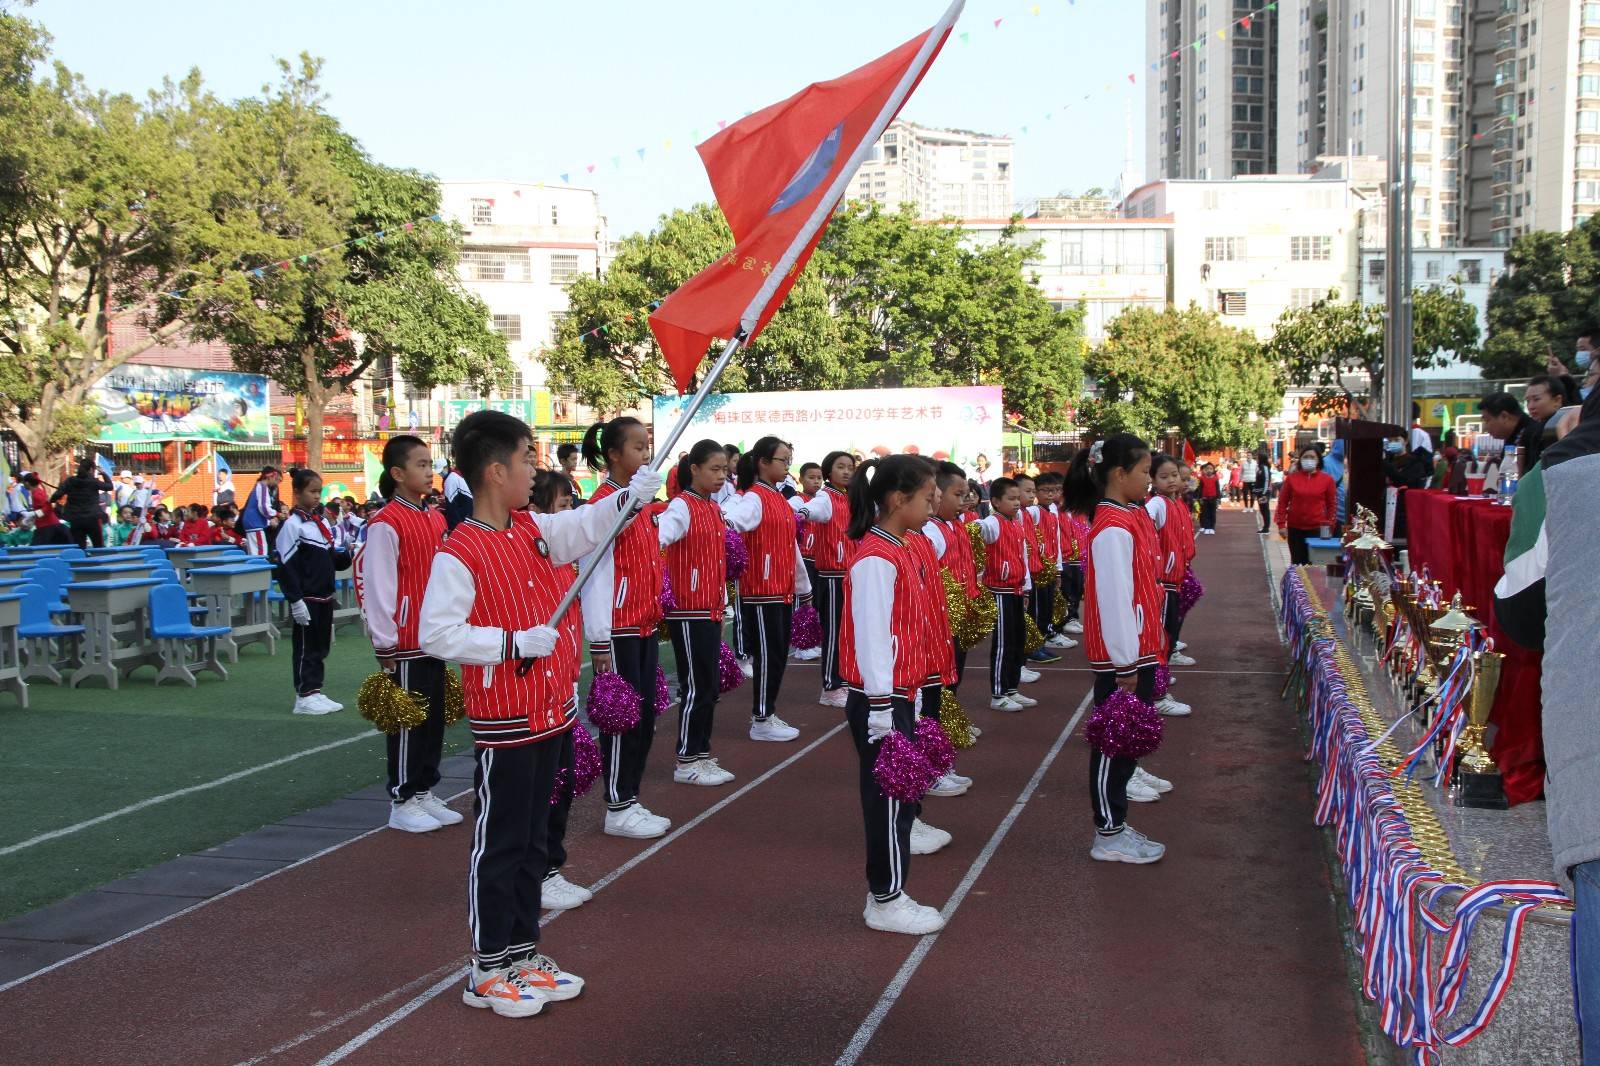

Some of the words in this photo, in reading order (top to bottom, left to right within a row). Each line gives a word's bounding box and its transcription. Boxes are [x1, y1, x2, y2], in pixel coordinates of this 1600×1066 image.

[714, 406, 943, 424] 海珠区聚德西路小学2020学年艺术节
